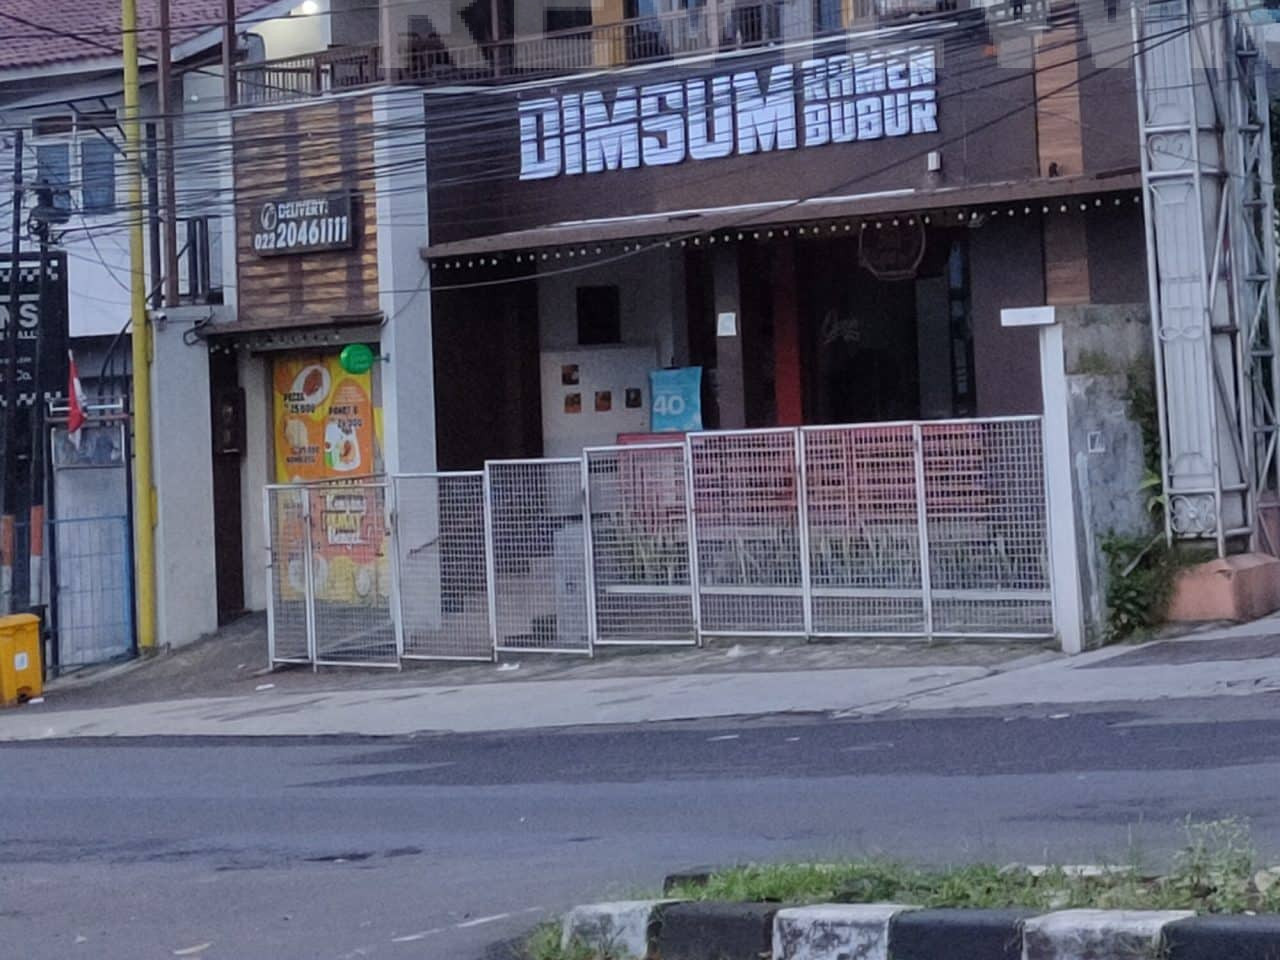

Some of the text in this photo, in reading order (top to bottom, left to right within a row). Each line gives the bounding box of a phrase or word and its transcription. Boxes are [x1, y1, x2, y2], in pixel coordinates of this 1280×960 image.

[801, 45, 936, 101] RAMEN
[518, 63, 798, 182] DIMSUM
[803, 89, 938, 147] BUBUR
[652, 394, 686, 417] 40
